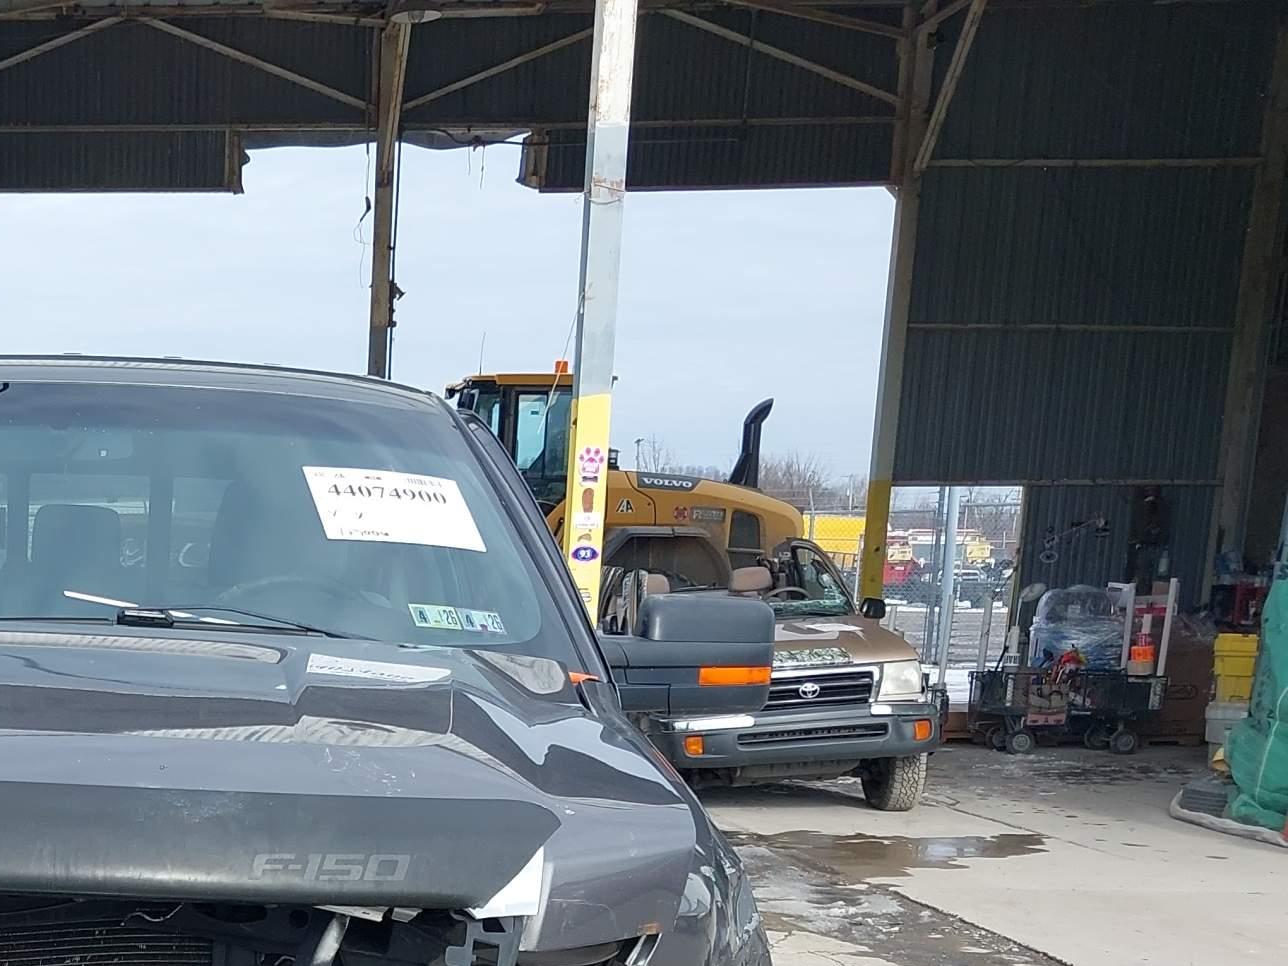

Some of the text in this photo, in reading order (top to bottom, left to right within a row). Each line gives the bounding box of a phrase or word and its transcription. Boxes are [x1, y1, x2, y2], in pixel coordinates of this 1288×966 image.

[642, 477, 693, 488] VOLVO
[328, 483, 447, 504] 44074900
[443, 609, 458, 626] 26
[488, 614, 503, 631] 26
[248, 853, 411, 881] F-150
